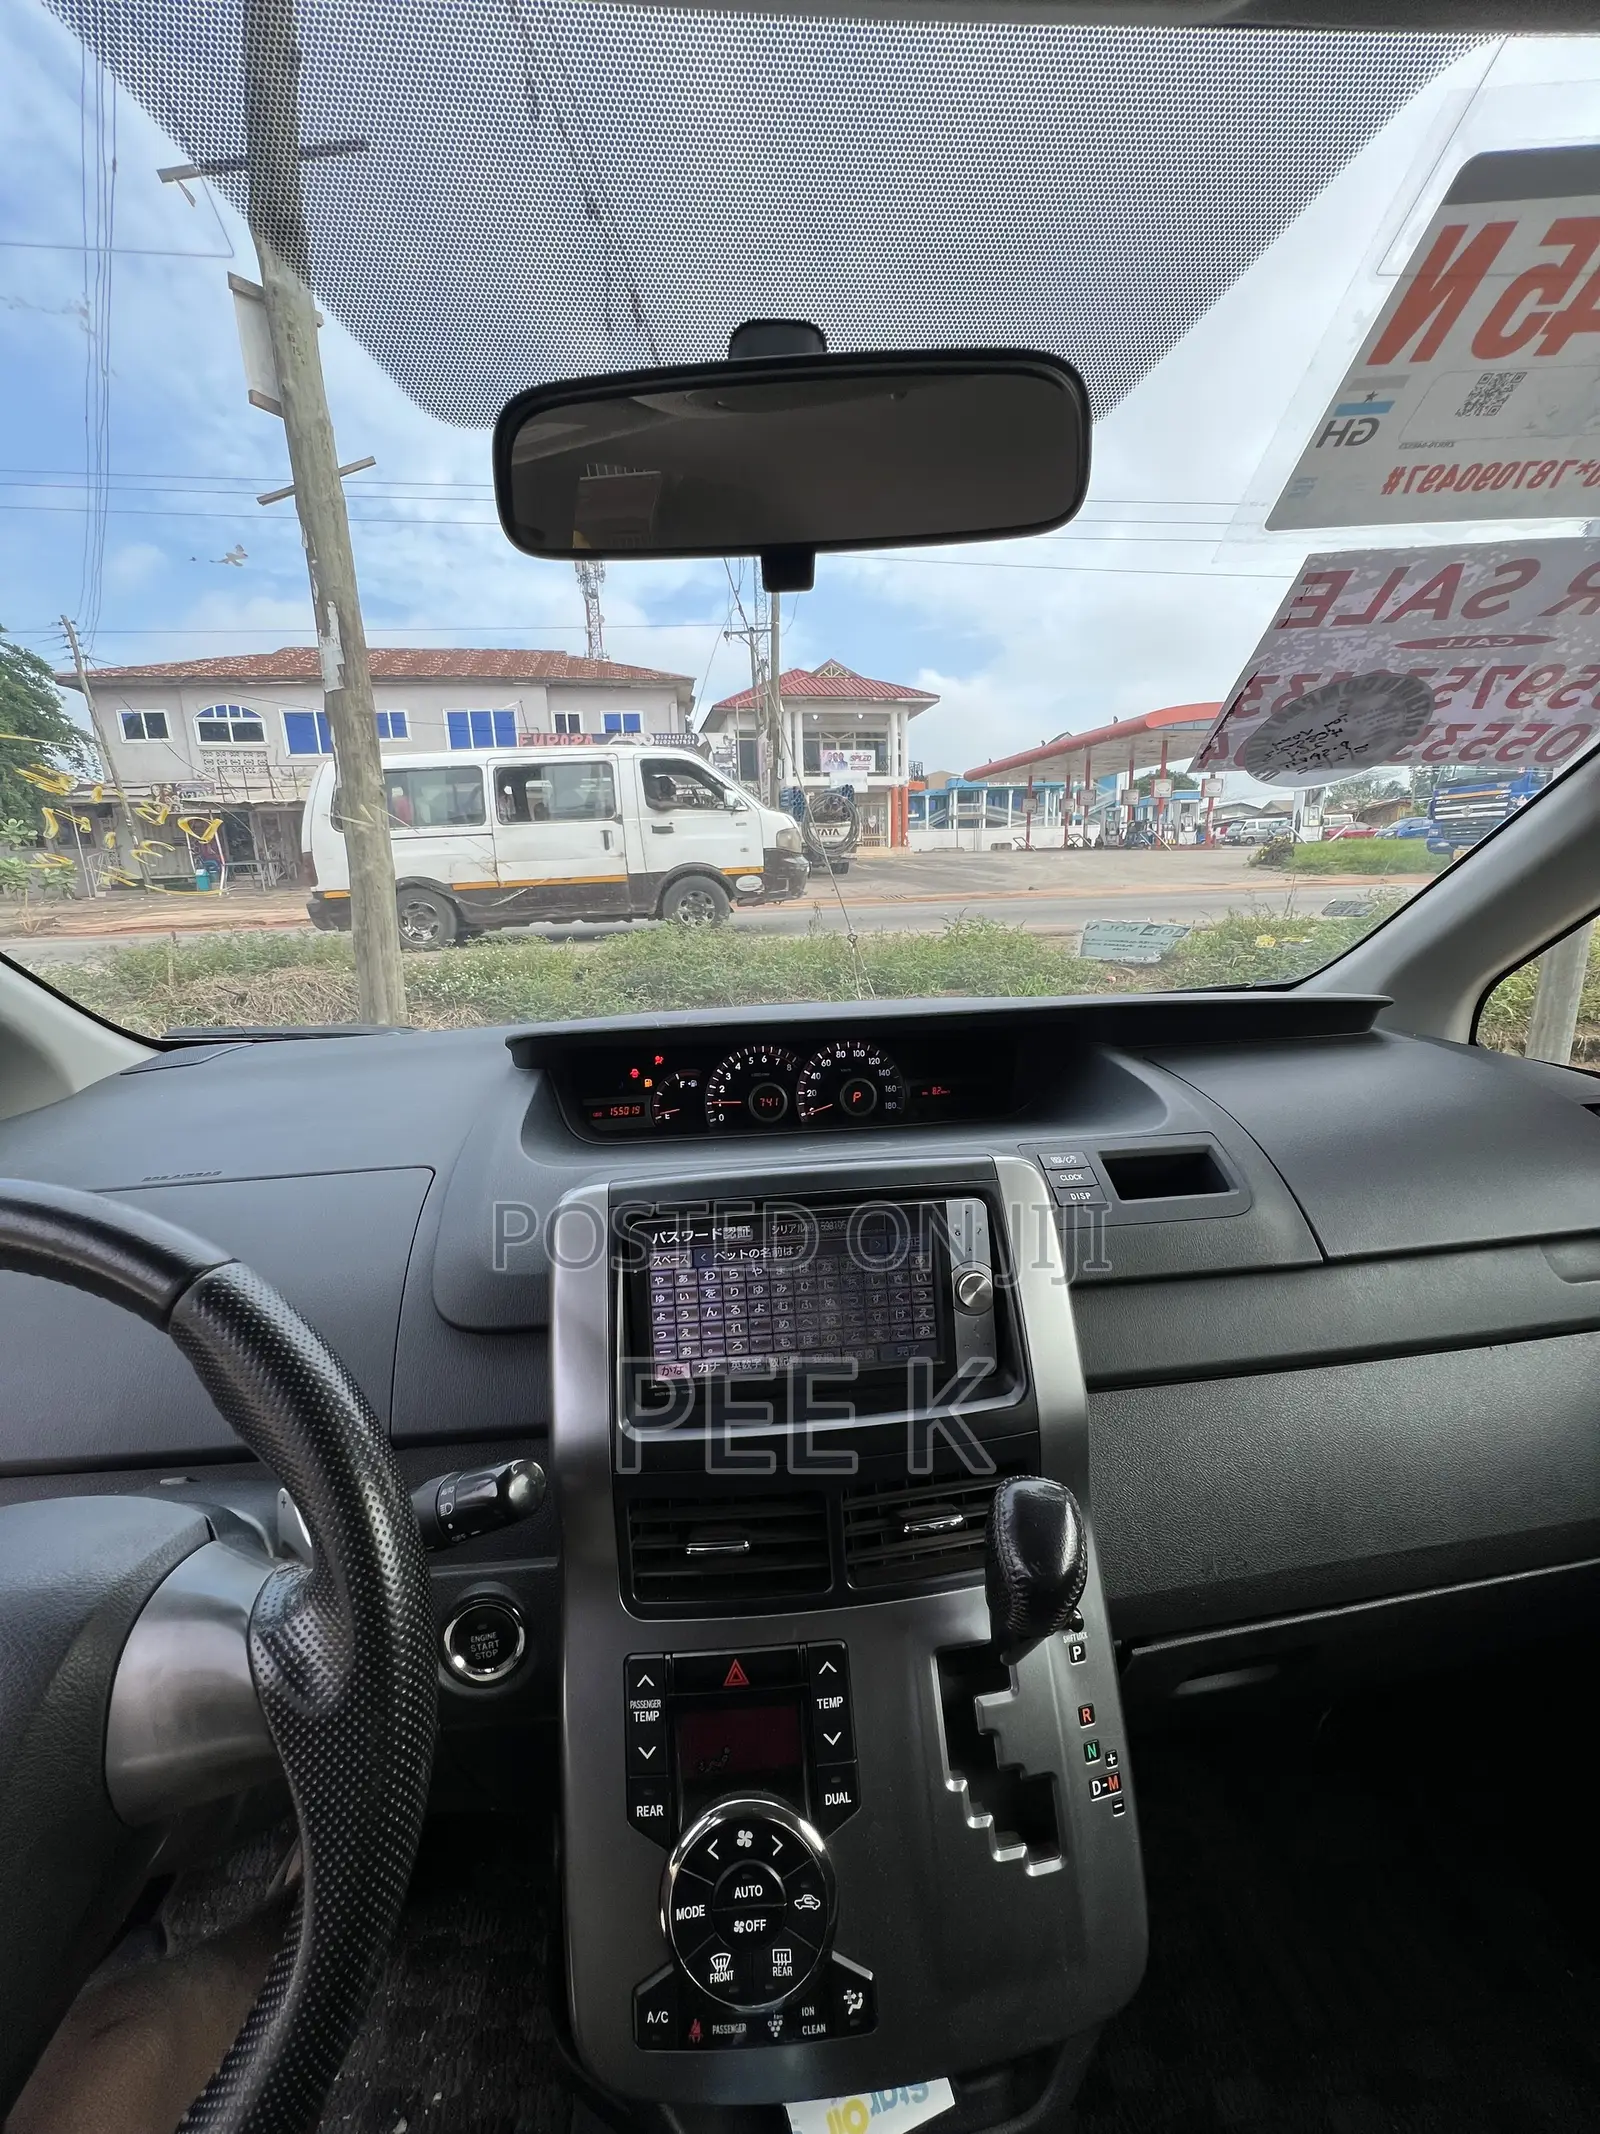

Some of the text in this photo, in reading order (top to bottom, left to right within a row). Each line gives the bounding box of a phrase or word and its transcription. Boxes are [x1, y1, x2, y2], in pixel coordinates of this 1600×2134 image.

[817, 828, 840, 836] TATA
[761, 1055, 767, 1063] 6
[836, 1050, 846, 1058] 80
[853, 1050, 865, 1058] 100
[734, 1062, 741, 1070] 4
[748, 1057, 754, 1065] 5
[775, 1058, 780, 1066] 7
[821, 1059, 831, 1067] 60
[868, 1057, 881, 1065] 120
[725, 1072, 731, 1080] 3
[811, 1072, 821, 1080] 40
[878, 1069, 891, 1077] 140
[719, 1085, 725, 1093] 2
[807, 1089, 817, 1097] 20
[885, 1085, 897, 1093] 160
[760, 1097, 779, 1107] 741
[853, 1091, 862, 1103] P
[610, 1105, 640, 1116] 155019
[885, 1102, 897, 1110] 180
[1070, 1192, 1091, 1200] DISP
[653, 1254, 689, 1266] スペース
[704, 1270, 716, 1281] わ
[729, 1269, 739, 1279] ら
[752, 1267, 763, 1277] や
[915, 1255, 926, 1265] あ
[705, 1288, 717, 1298] を
[730, 1287, 739, 1297] り
[753, 1285, 764, 1294] ゆ
[776, 1283, 788, 1293] み
[800, 1282, 811, 1292] ひ
[823, 1280, 834, 1290] に
[871, 1275, 879, 1285] し
[915, 1273, 928, 1283] い
[706, 1307, 717, 1317] ん
[730, 1304, 741, 1315] る
[754, 1303, 765, 1313] よ
[777, 1301, 789, 1311] む
[801, 1300, 812, 1309] ふ
[872, 1294, 883, 1303] す
[895, 1292, 903, 1301] く
[917, 1291, 928, 1300] う
[730, 1323, 742, 1333] れ
[778, 1319, 790, 1329] め
[872, 1312, 883, 1321] せ
[895, 1310, 906, 1319] け
[918, 1308, 930, 1318] え
[732, 1341, 743, 1351] ろ
[780, 1337, 791, 1347] も
[803, 1335, 814, 1345] ほ
[826, 1334, 837, 1343] の
[851, 1332, 860, 1342] と
[896, 1329, 907, 1338] こ
[919, 1326, 931, 1336] お
[661, 1365, 684, 1376] かな
[698, 1362, 720, 1373] カナ
[470, 1631, 497, 1643] ENGINE
[470, 1639, 500, 1653] START
[475, 1648, 499, 1660] STOP
[1072, 1645, 1082, 1660] P
[630, 1699, 661, 1709] PASSENGER
[817, 1697, 843, 1710] TEMP
[633, 1711, 660, 1722] TEMP
[1082, 1708, 1092, 1723] R
[1087, 1744, 1097, 1759] N
[1091, 1775, 1119, 1796] D-M
[825, 1792, 851, 1806] DUAL
[636, 1805, 664, 1818] REAR
[734, 1884, 763, 1899] AUTO
[676, 1905, 706, 1921] MODE
[745, 1919, 767, 1932] OFF
[709, 1969, 734, 1984] FRONT
[772, 1965, 793, 1977] REAR
[647, 2011, 669, 2024] A/C
[801, 2006, 815, 2017] ION
[712, 2023, 747, 2035] PASSENGER
[802, 2023, 827, 2035] CLEAN
